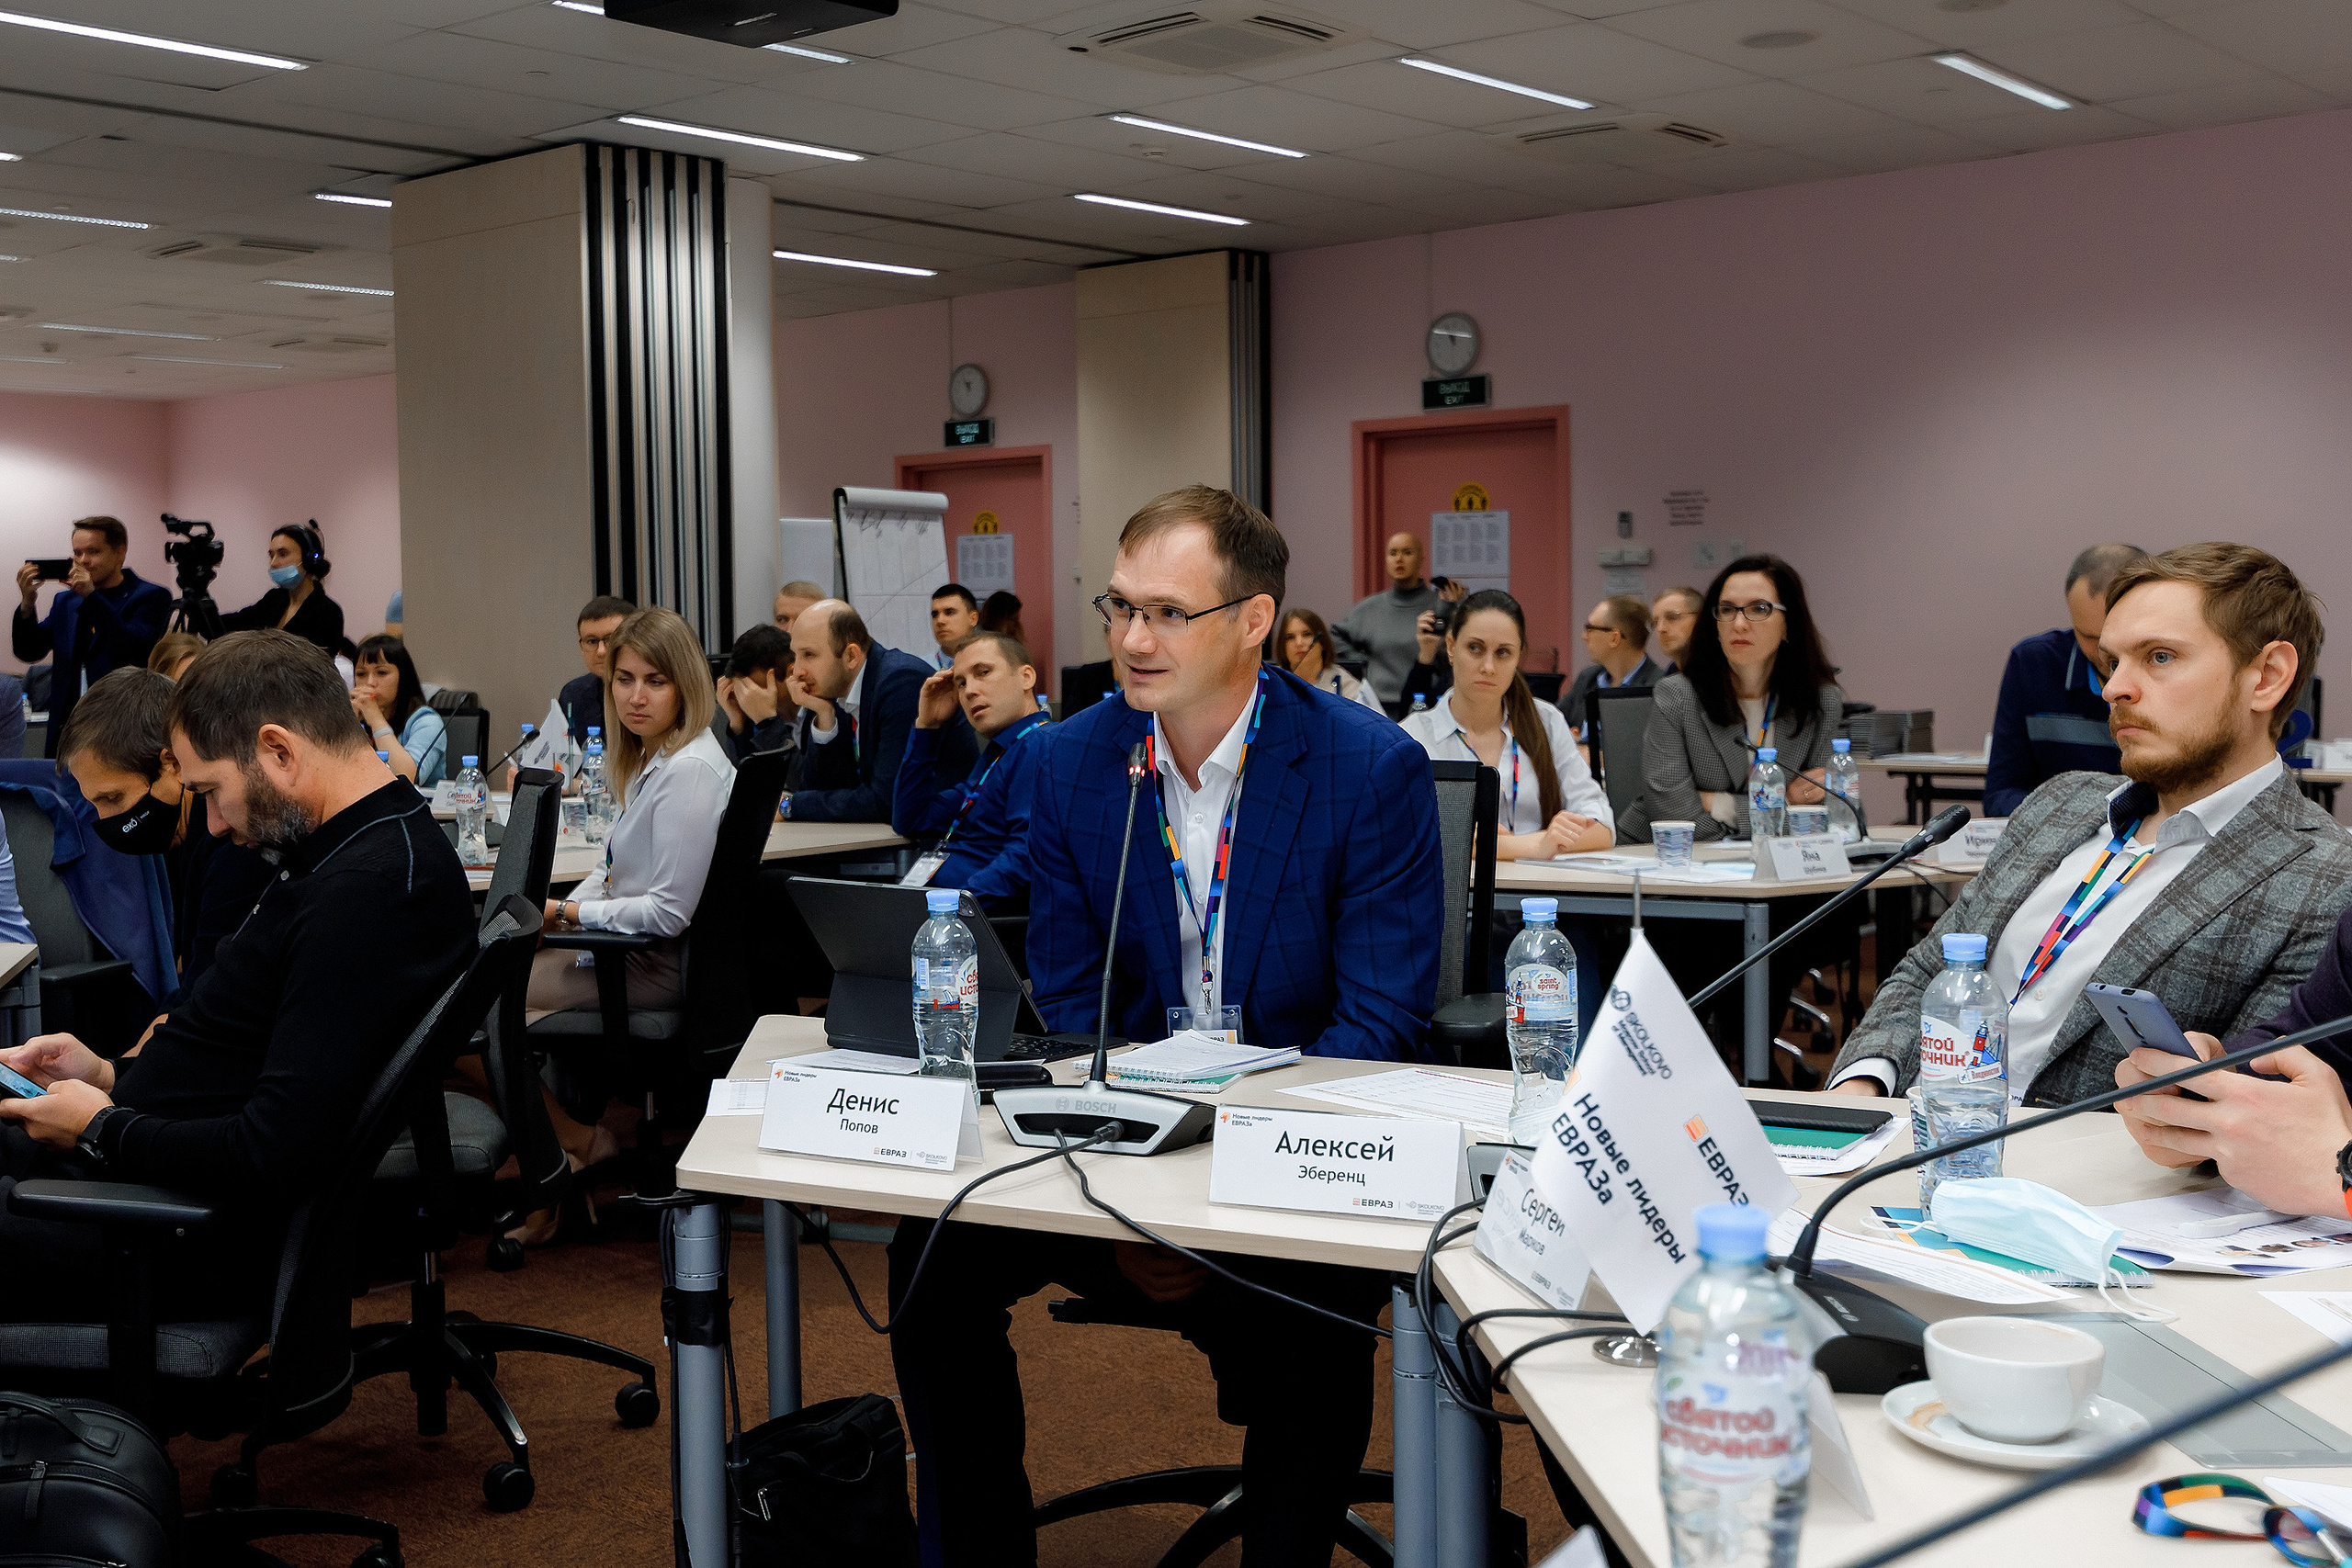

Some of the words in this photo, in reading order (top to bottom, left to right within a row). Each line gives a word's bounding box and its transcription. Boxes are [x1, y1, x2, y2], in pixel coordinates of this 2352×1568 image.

[1537, 983, 1559, 991] spring
[1624, 1011, 1672, 1079] SKOLKOVO
[826, 1088, 900, 1115] Денис
[1074, 1100, 1117, 1114] BOSCH
[840, 1118, 879, 1134] Попов
[880, 1147, 908, 1158] ЕВРАЗ
[1275, 1130, 1395, 1162] Алексей
[1551, 1111, 1614, 1206] ЕВРАЗа
[1298, 1165, 1366, 1187] Эберенц
[1573, 1092, 1631, 1174] Новые
[1625, 1178, 1687, 1264] лидеры
[1361, 1198, 1394, 1209] ЕВРАЗ
[1518, 1227, 1546, 1256] Марков
